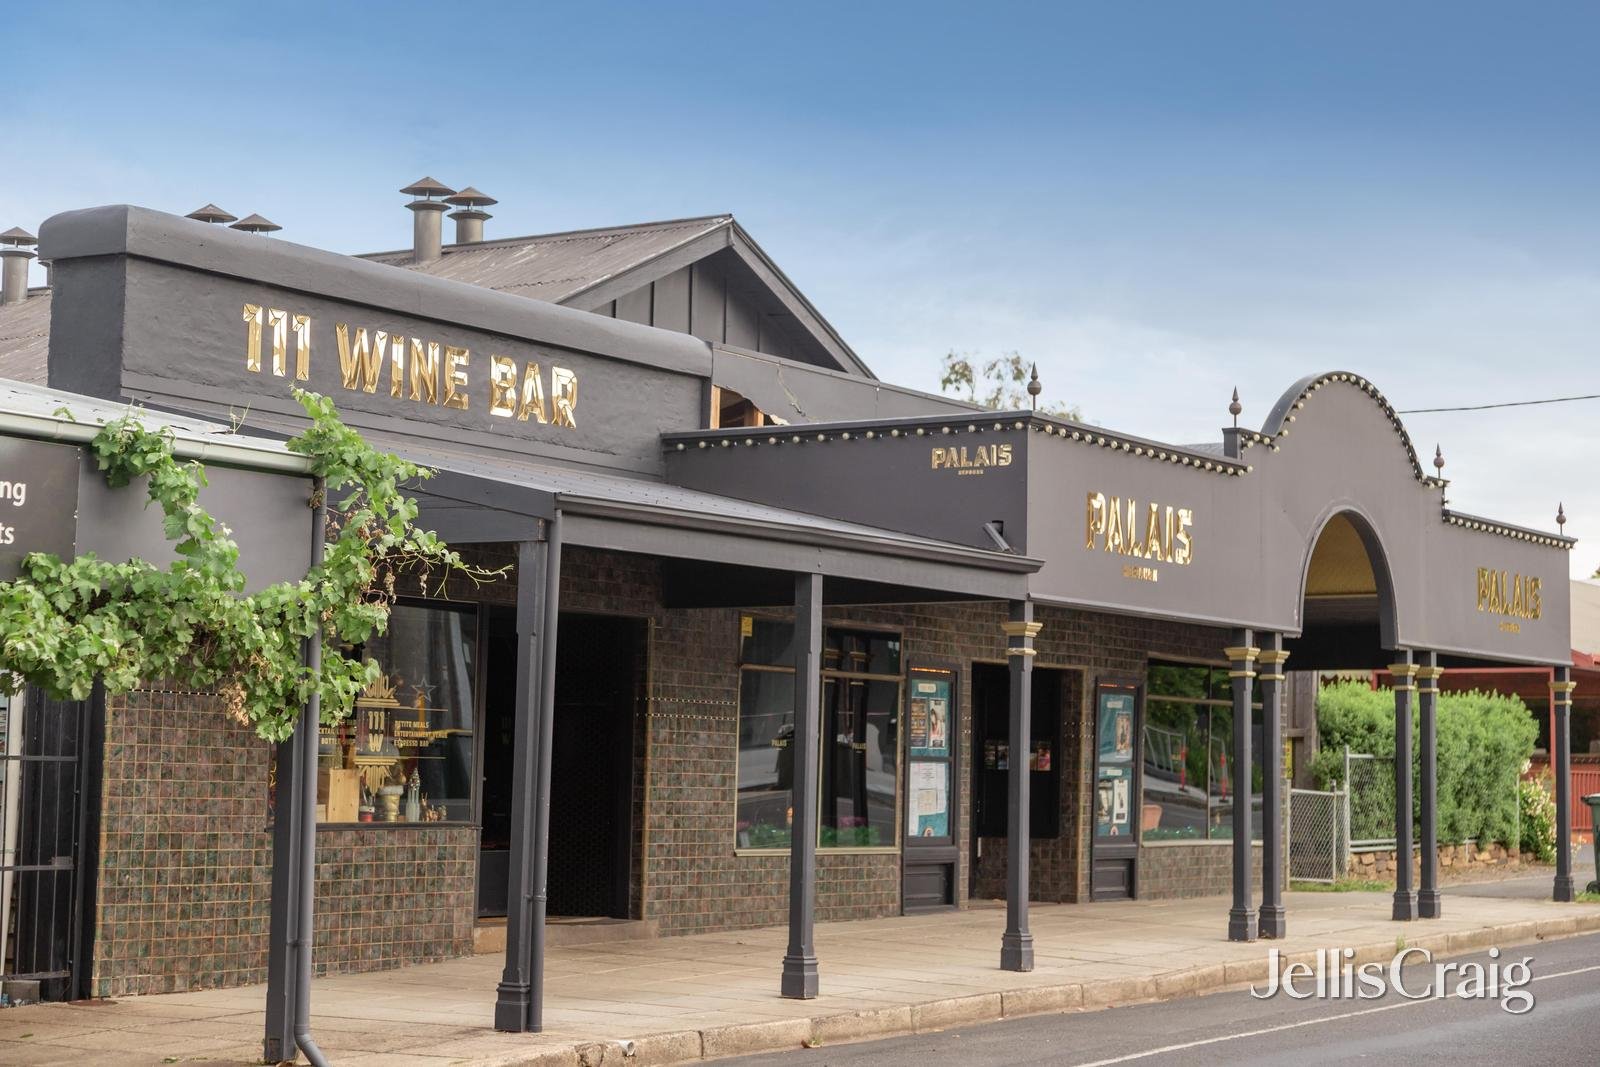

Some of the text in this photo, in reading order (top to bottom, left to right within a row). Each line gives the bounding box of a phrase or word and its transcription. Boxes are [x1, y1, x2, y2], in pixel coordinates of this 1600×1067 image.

[242, 303, 578, 429] 111 WINE BAR
[931, 443, 1013, 470] PALAIS
[1086, 491, 1193, 566] PALAIS
[1477, 566, 1542, 620] PALAIS
